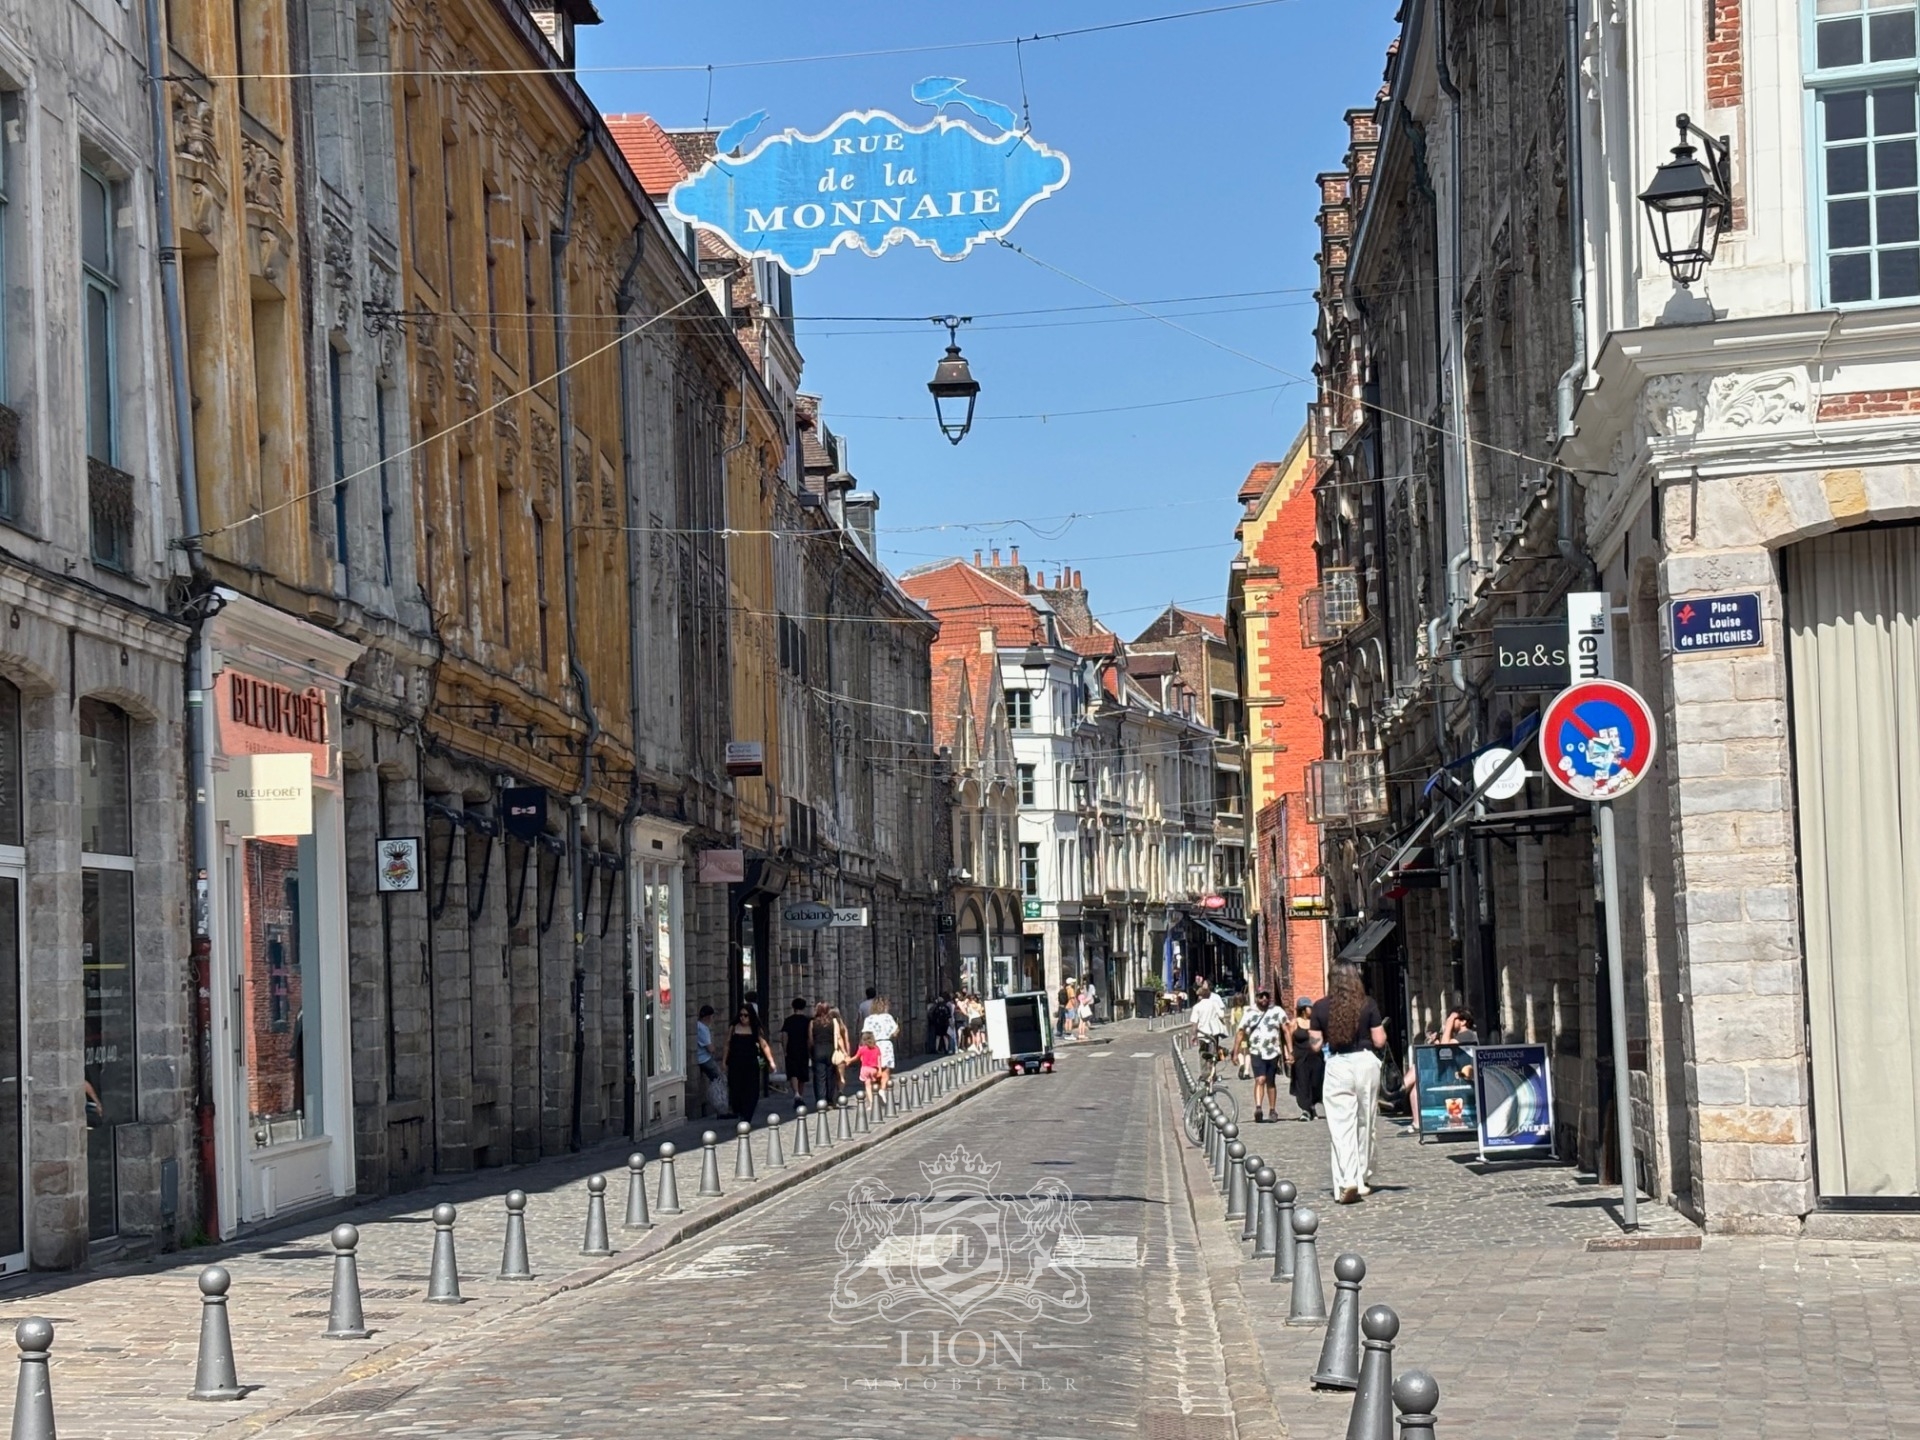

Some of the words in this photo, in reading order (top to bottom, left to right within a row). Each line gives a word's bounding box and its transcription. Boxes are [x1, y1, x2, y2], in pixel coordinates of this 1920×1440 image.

[831, 133, 905, 155] RUE
[818, 168, 855, 192] de
[883, 163, 917, 187] la
[743, 188, 1000, 233] MONNAIE
[1711, 602, 1737, 613] Place
[1709, 616, 1741, 629] Louise
[1681, 635, 1693, 646] de
[1695, 630, 1753, 645] BETTIGNIES
[1499, 644, 1569, 667] ba&s
[1578, 628, 1605, 679] lem
[231, 673, 328, 744] BLEUFORÊT
[236, 786, 303, 799] BLEUFORÊT
